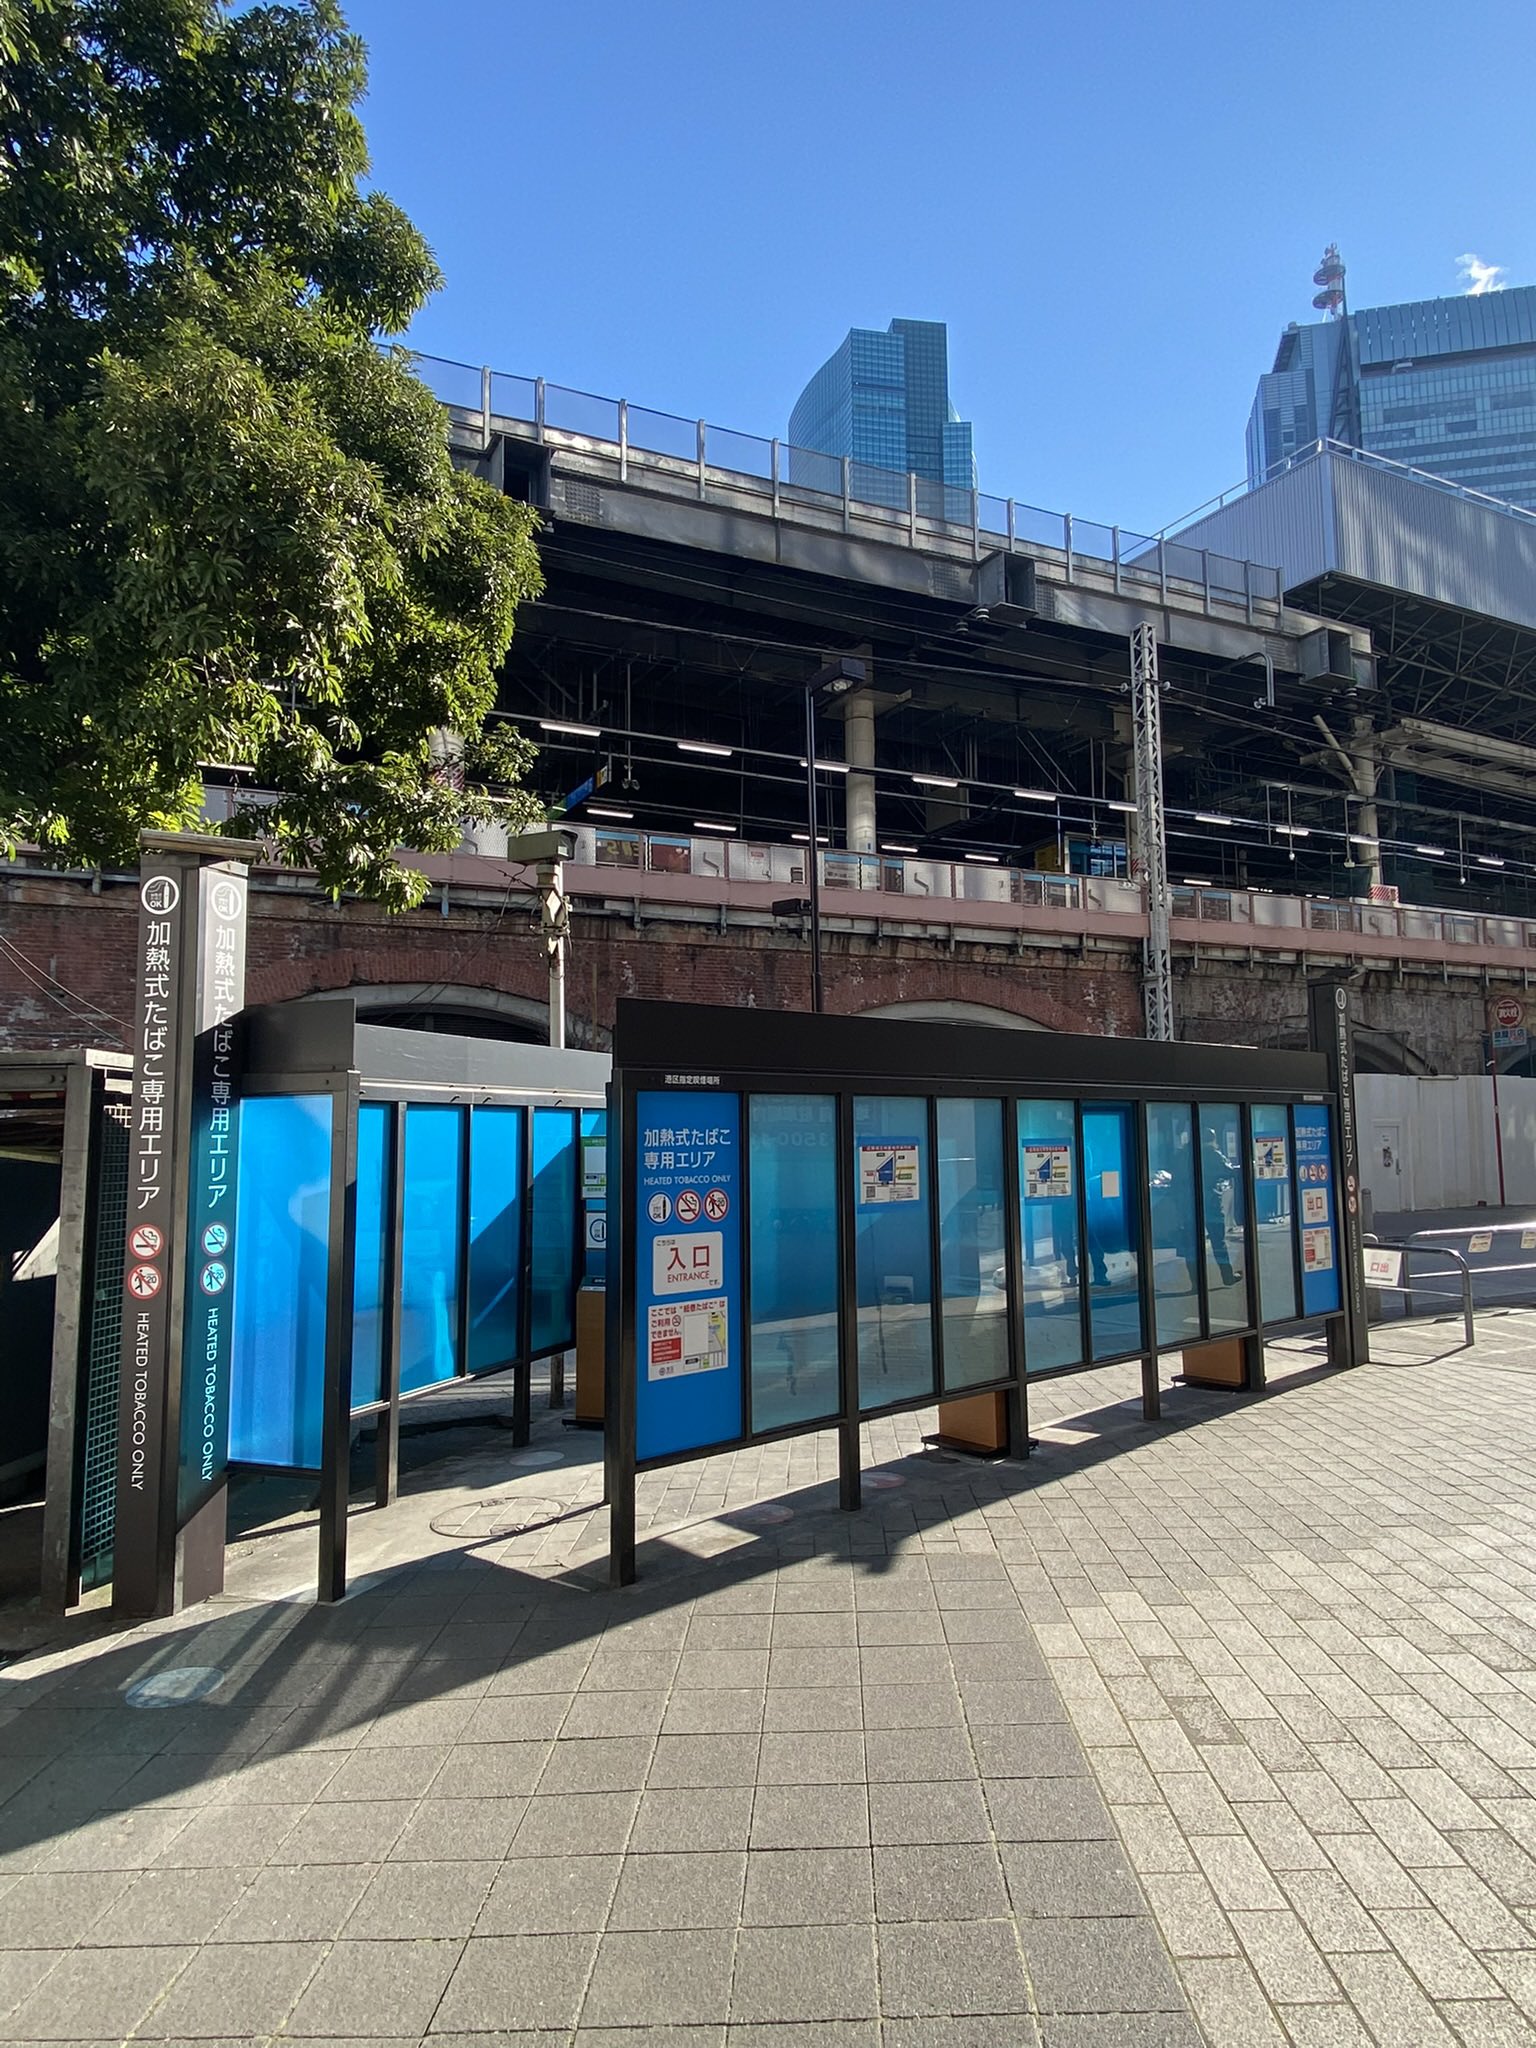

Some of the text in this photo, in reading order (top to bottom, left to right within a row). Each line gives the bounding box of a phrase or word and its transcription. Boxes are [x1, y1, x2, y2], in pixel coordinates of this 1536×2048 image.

[150, 900, 162, 908] OK
[137, 921, 172, 1210] 加熱式たばこ専用エリア
[207, 925, 236, 1208] 加熱式たばこ専用エリア
[643, 1128, 731, 1146] 加熱式たばこ
[644, 1151, 716, 1170] 専用エリア
[643, 1174, 731, 1186] HEATED TOBACCO ONLY
[667, 1245, 710, 1271] 入口
[146, 1275, 157, 1284] 20
[667, 1271, 710, 1283] ENTRANCE
[651, 1307, 677, 1318] ここでは
[131, 1312, 150, 1491] HEATED TOBACCO ONLY
[201, 1308, 219, 1482] HEATED TOBACCO ONLY
